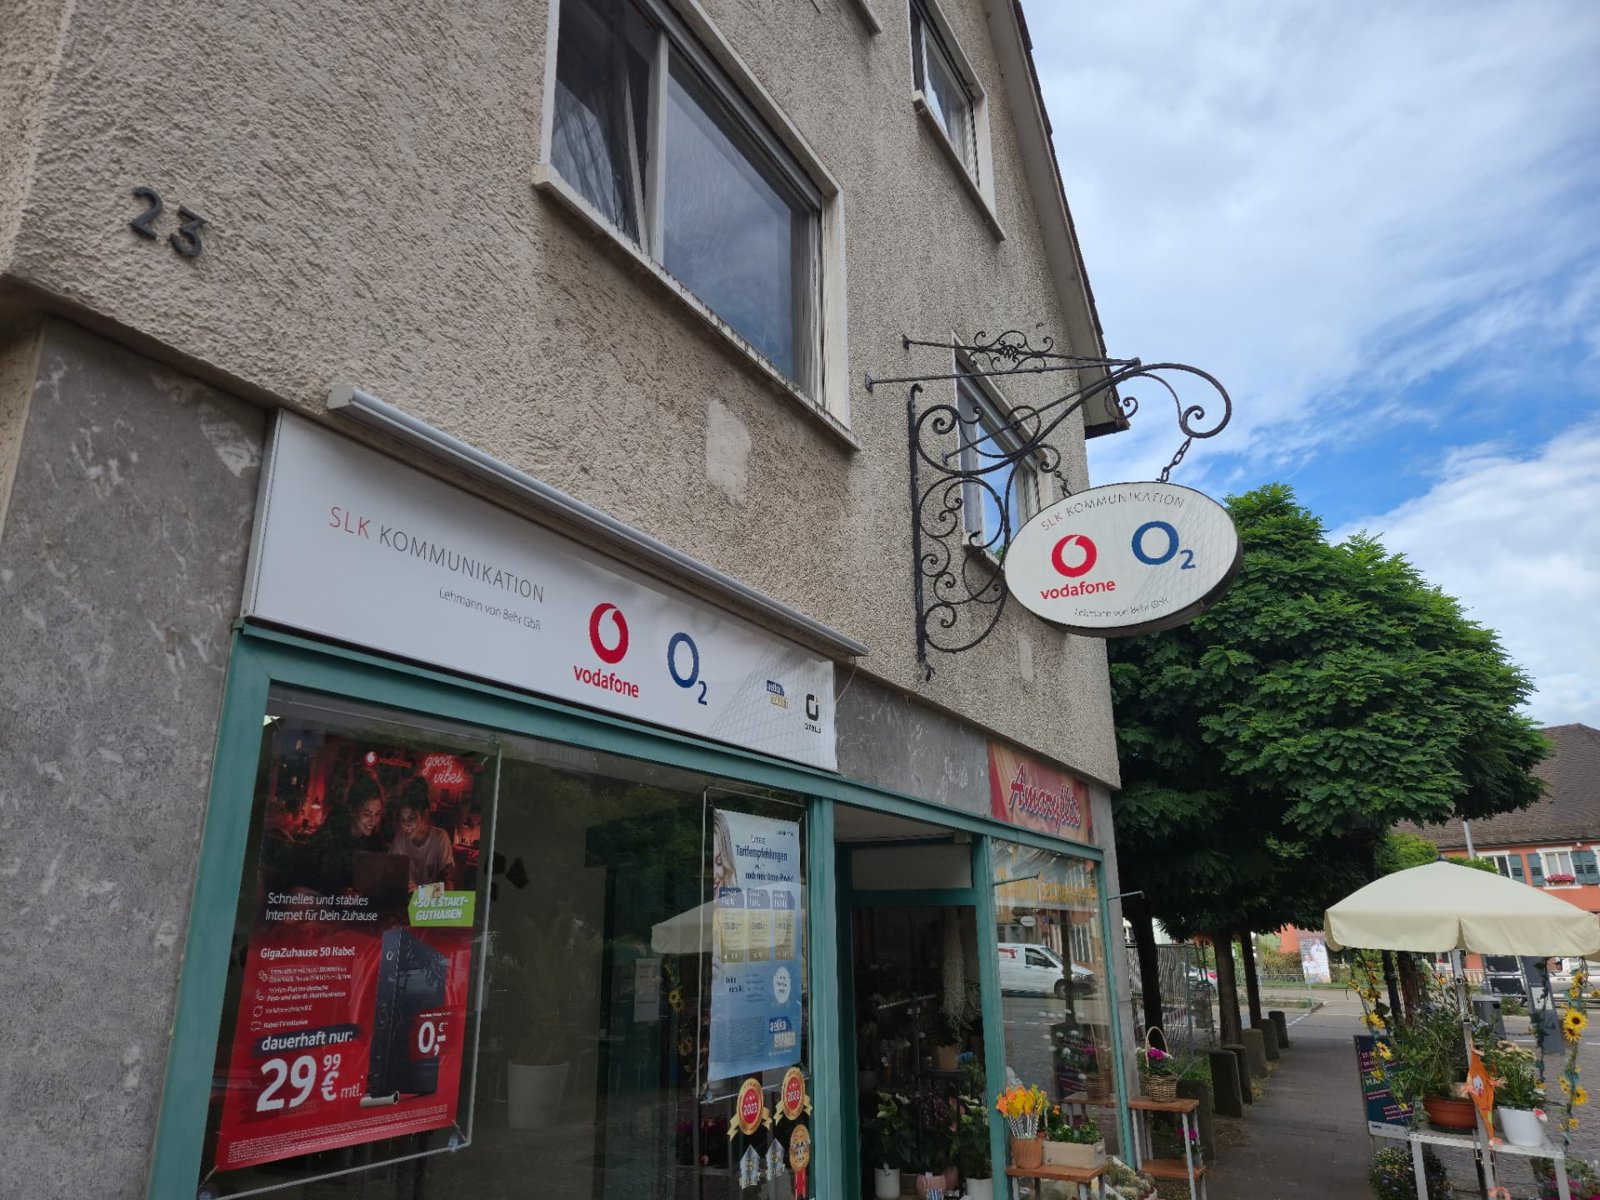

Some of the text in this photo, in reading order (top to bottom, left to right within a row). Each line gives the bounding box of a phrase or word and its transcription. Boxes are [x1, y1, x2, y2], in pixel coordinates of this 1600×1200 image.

[130, 186, 209, 257] 23
[1041, 492, 1185, 531] SLK KOMMUNIKATION
[329, 506, 545, 603] SLK KOMMUNIKATION
[1040, 580, 1117, 599] vodafone
[439, 586, 541, 630] Lehmann von Behr GbR
[574, 665, 640, 698] vodafone
[423, 755, 454, 776] good
[433, 766, 463, 784] vibes
[268, 892, 369, 906] Schnelles und stabiles
[265, 908, 378, 922] Internet für Dein Zuhause
[416, 909, 462, 921] GUTHABEN
[260, 946, 355, 960] GigaZuhause 50 Kabel
[261, 1030, 353, 1050] dauerhaft nur:
[256, 1054, 363, 1112] 29 99 € mtl.
[743, 1102, 758, 1116] 2023
